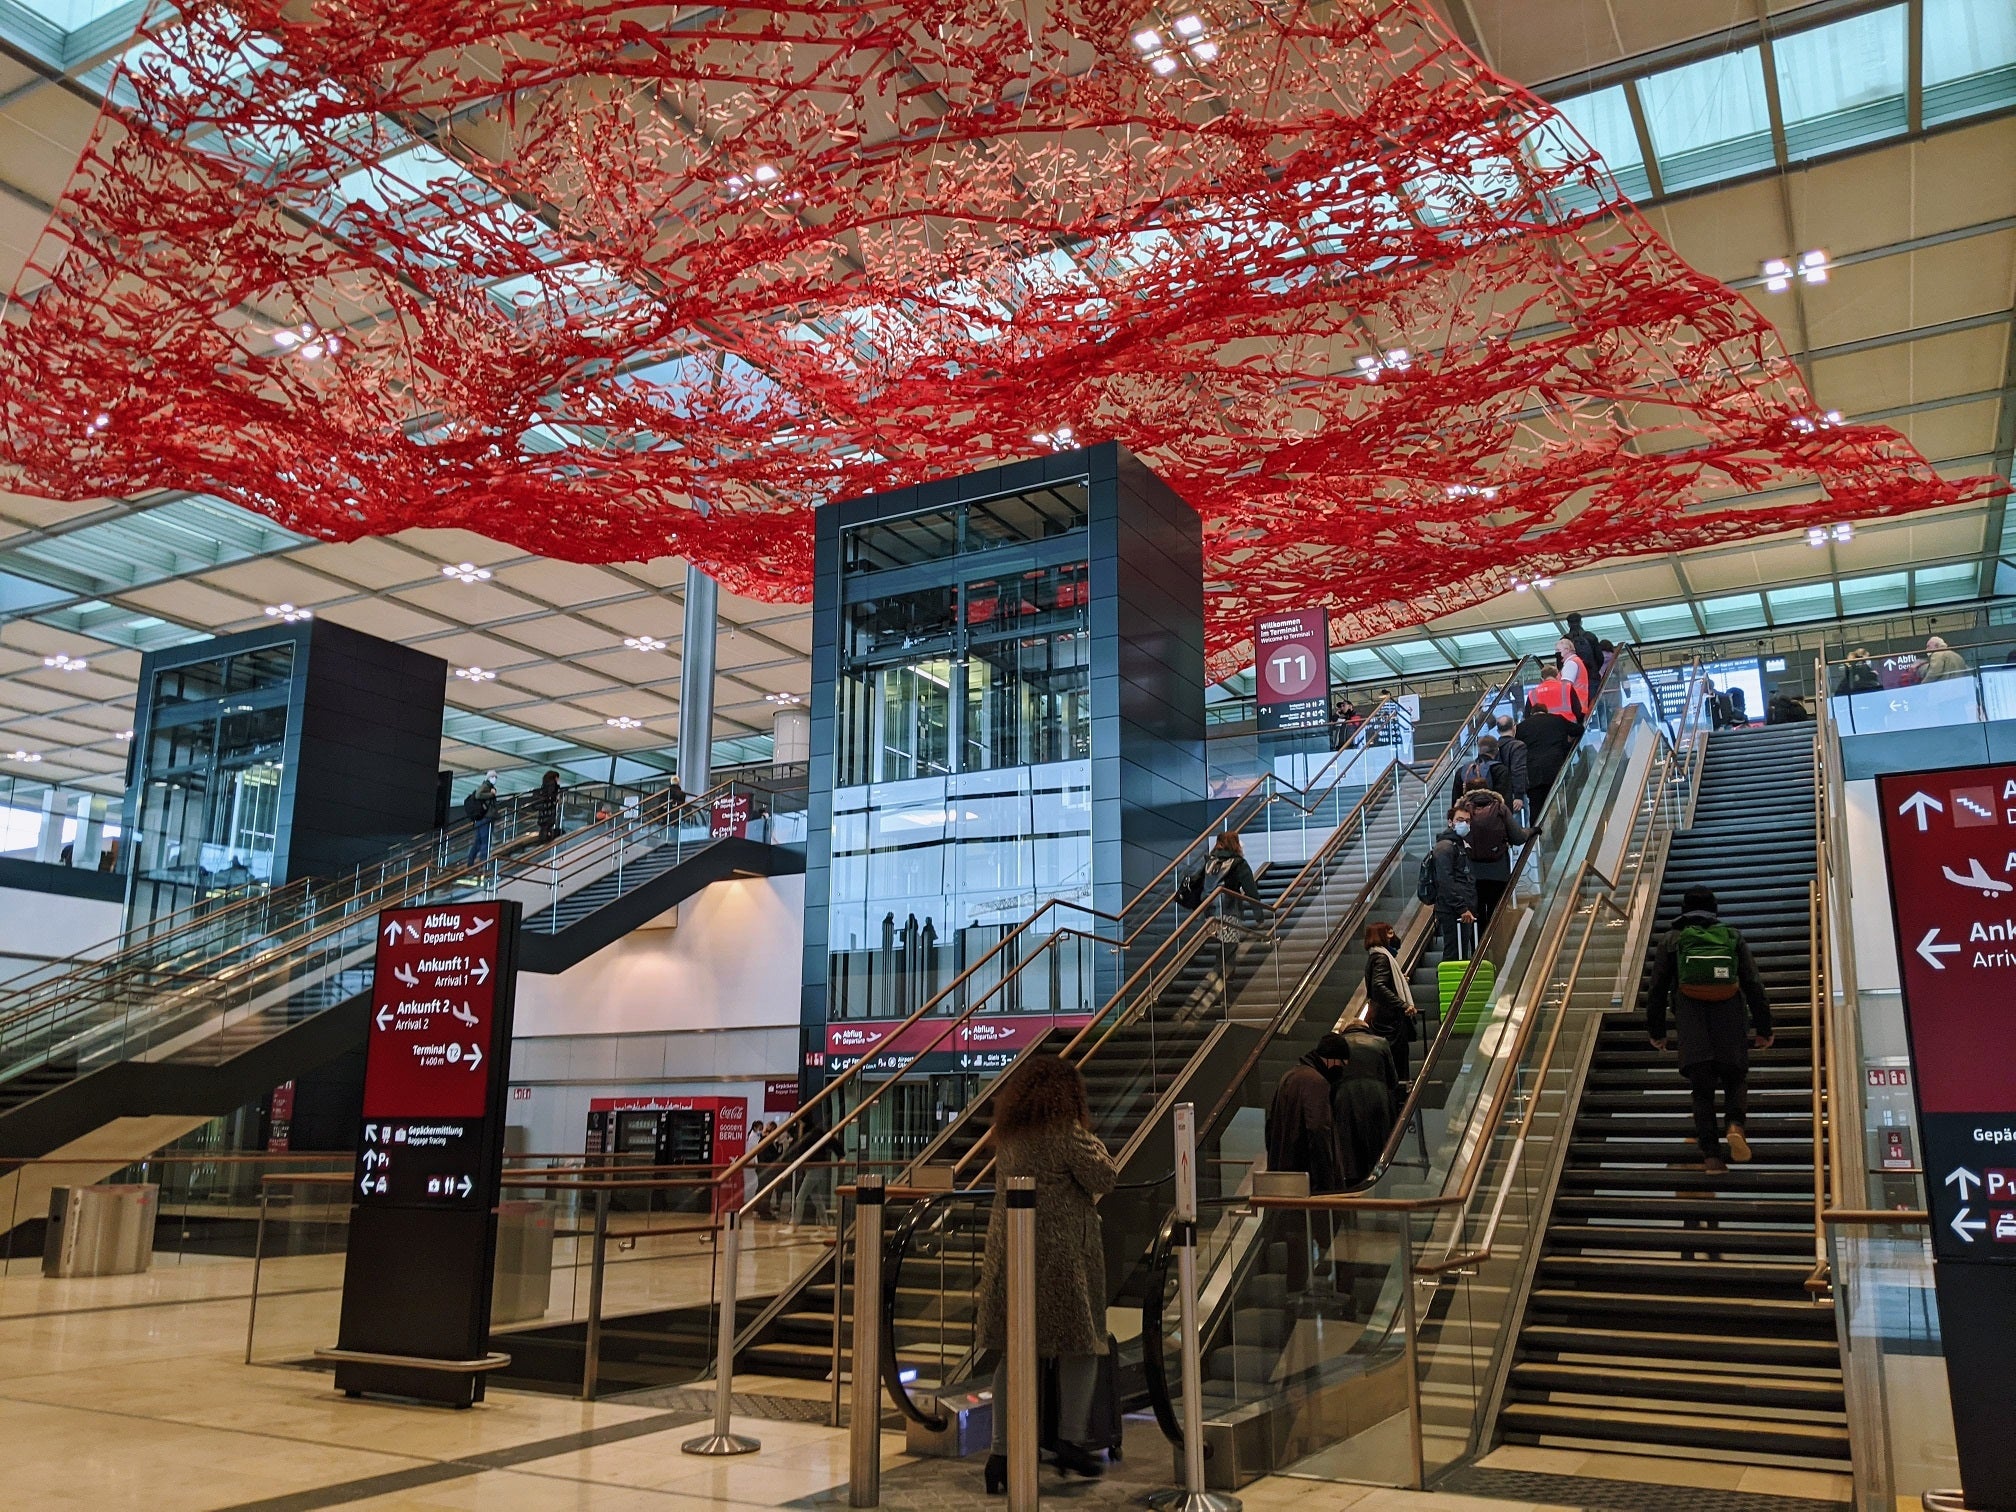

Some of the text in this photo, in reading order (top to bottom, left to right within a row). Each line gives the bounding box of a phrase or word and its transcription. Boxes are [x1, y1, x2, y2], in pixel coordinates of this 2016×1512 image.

[1260, 618, 1301, 630] Willkommen
[1270, 625, 1299, 636] Terminal
[1260, 635, 1283, 644] Welcome
[1289, 630, 1311, 640] Terminal
[1272, 655, 1307, 684] T1
[424, 913, 460, 930] Abflug
[423, 931, 465, 946] Departure
[417, 956, 470, 973] Ankunft 1
[434, 974, 468, 988] Arrival 1
[396, 999, 450, 1015] Ankunft 2
[395, 1018, 429, 1031] Arrival 2
[973, 1025, 994, 1035] Abflug
[842, 1030, 863, 1039] Abflug
[973, 1034, 998, 1042] Departure
[412, 1043, 446, 1056] Terminal
[720, 1106, 744, 1120] Coca-Cola
[408, 1125, 464, 1138] Gepäckermittlung
[720, 1124, 742, 1132] GOODBYE
[407, 1136, 447, 1146] Baggage Tracing
[720, 1132, 742, 1140] BERLIN
[378, 1152, 389, 1168] P1
